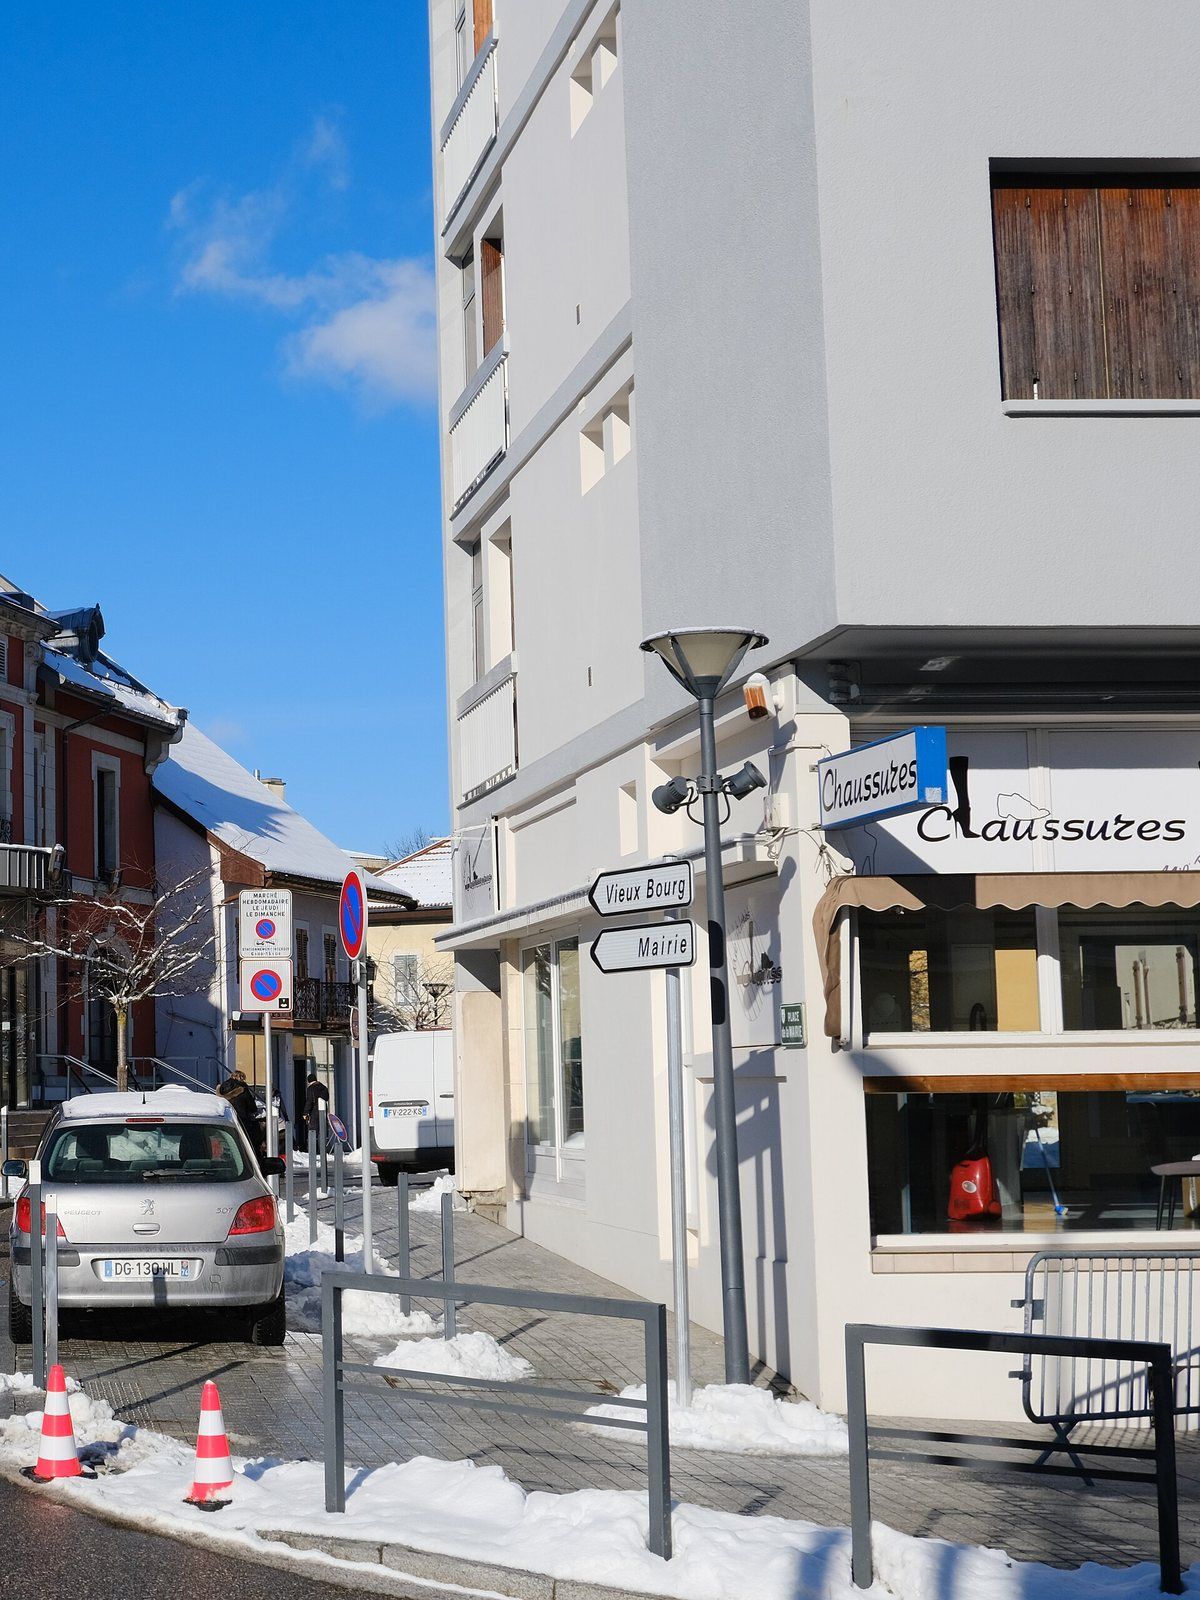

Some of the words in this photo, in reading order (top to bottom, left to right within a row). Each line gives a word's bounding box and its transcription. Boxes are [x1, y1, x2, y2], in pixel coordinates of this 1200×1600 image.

[822, 759, 917, 812] Chaussures
[606, 883, 640, 904] Vieux
[646, 878, 686, 900] Bourg
[638, 934, 687, 958] Mairie
[787, 1011, 800, 1023] PLACE
